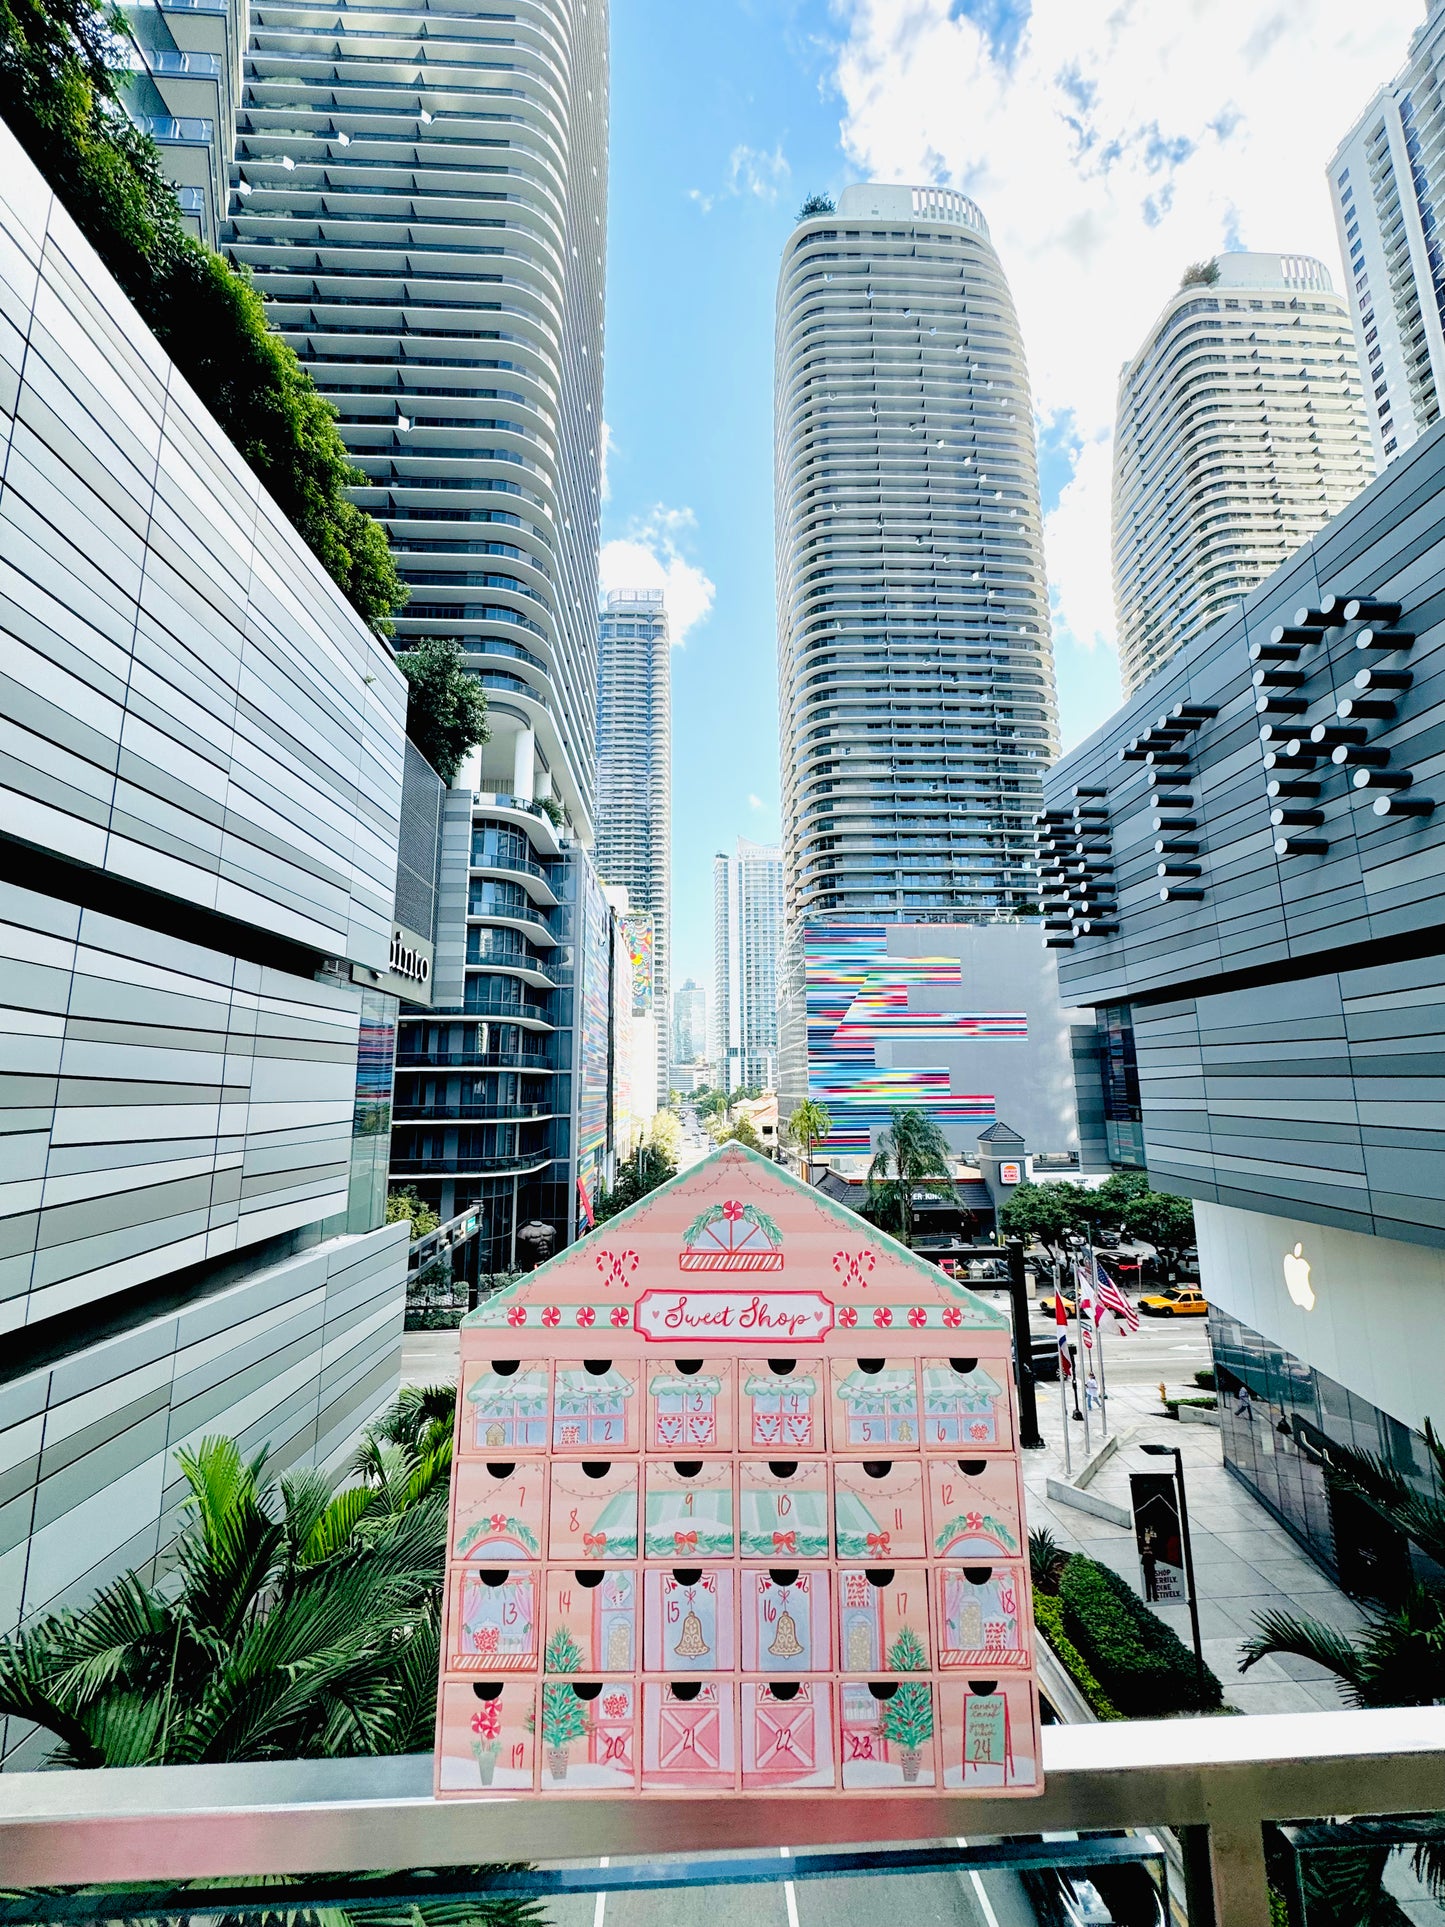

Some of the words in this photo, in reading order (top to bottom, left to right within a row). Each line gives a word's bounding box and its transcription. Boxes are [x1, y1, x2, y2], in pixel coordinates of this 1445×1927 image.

[390, 931, 429, 981] uinto
[665, 1296, 735, 1328] Sweet
[739, 1296, 811, 1336] Shop
[693, 1392, 704, 1412] 3
[790, 1394, 799, 1414] 4
[604, 1421, 613, 1441] 2
[862, 1420, 872, 1441] 5
[937, 1420, 947, 1442] 6
[518, 1486, 526, 1507] 7
[685, 1491, 693, 1516] 9
[776, 1494, 791, 1516] 10
[942, 1484, 954, 1506] 12
[569, 1508, 580, 1532] 8
[895, 1508, 903, 1530] 11
[1154, 1569, 1171, 1577] SHOP
[1155, 1576, 1178, 1584] ERRILY.
[502, 1601, 518, 1625] 13
[559, 1590, 571, 1614] 14
[667, 1600, 680, 1624] 15
[763, 1600, 776, 1622] 16
[896, 1592, 907, 1616] 17
[1002, 1590, 1016, 1614] 18
[605, 1736, 625, 1760] 20
[682, 1728, 695, 1752] 21
[775, 1728, 793, 1751] 22
[851, 1736, 873, 1760] 23
[973, 1738, 991, 1761] 24
[511, 1743, 524, 1769] 19
